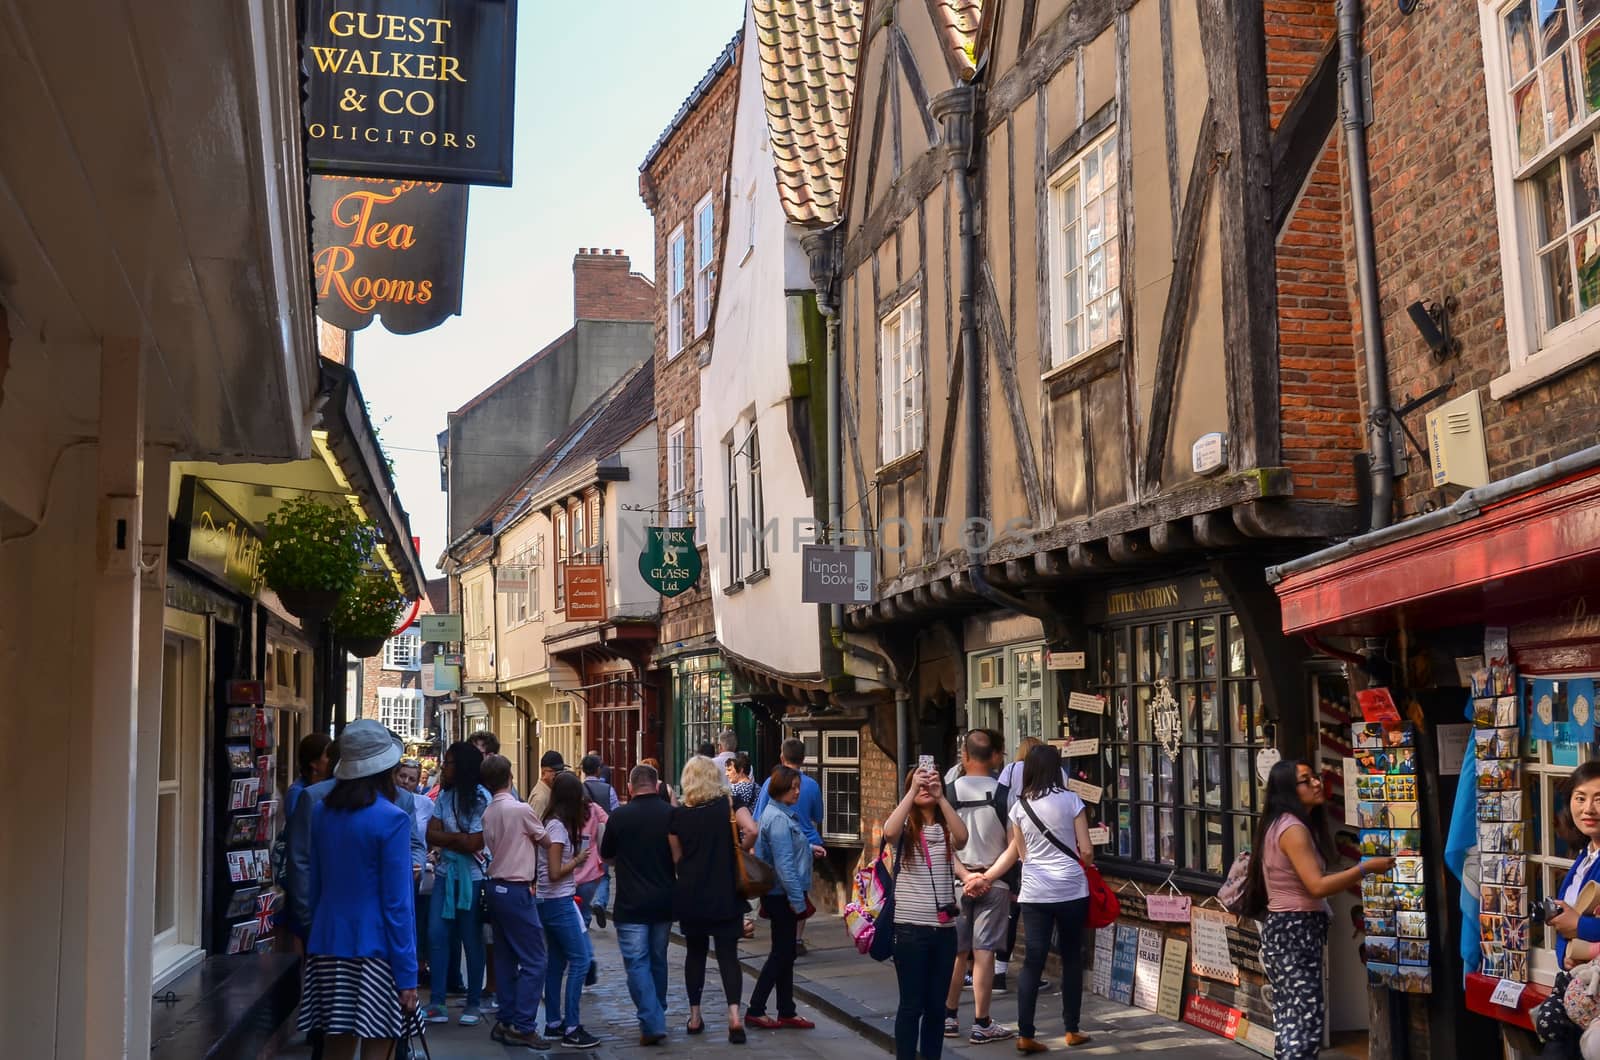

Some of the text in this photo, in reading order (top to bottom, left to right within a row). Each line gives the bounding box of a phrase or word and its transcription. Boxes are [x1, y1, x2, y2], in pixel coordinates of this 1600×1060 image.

[329, 11, 452, 44] GUEST
[310, 46, 467, 82] WALKER
[339, 87, 435, 116] & CO
[331, 190, 417, 250] Tea
[313, 246, 433, 313] Rooms
[655, 531, 687, 544] YORK
[651, 568, 690, 580] GLASS
[809, 560, 848, 574] lunch
[821, 572, 847, 585] box
